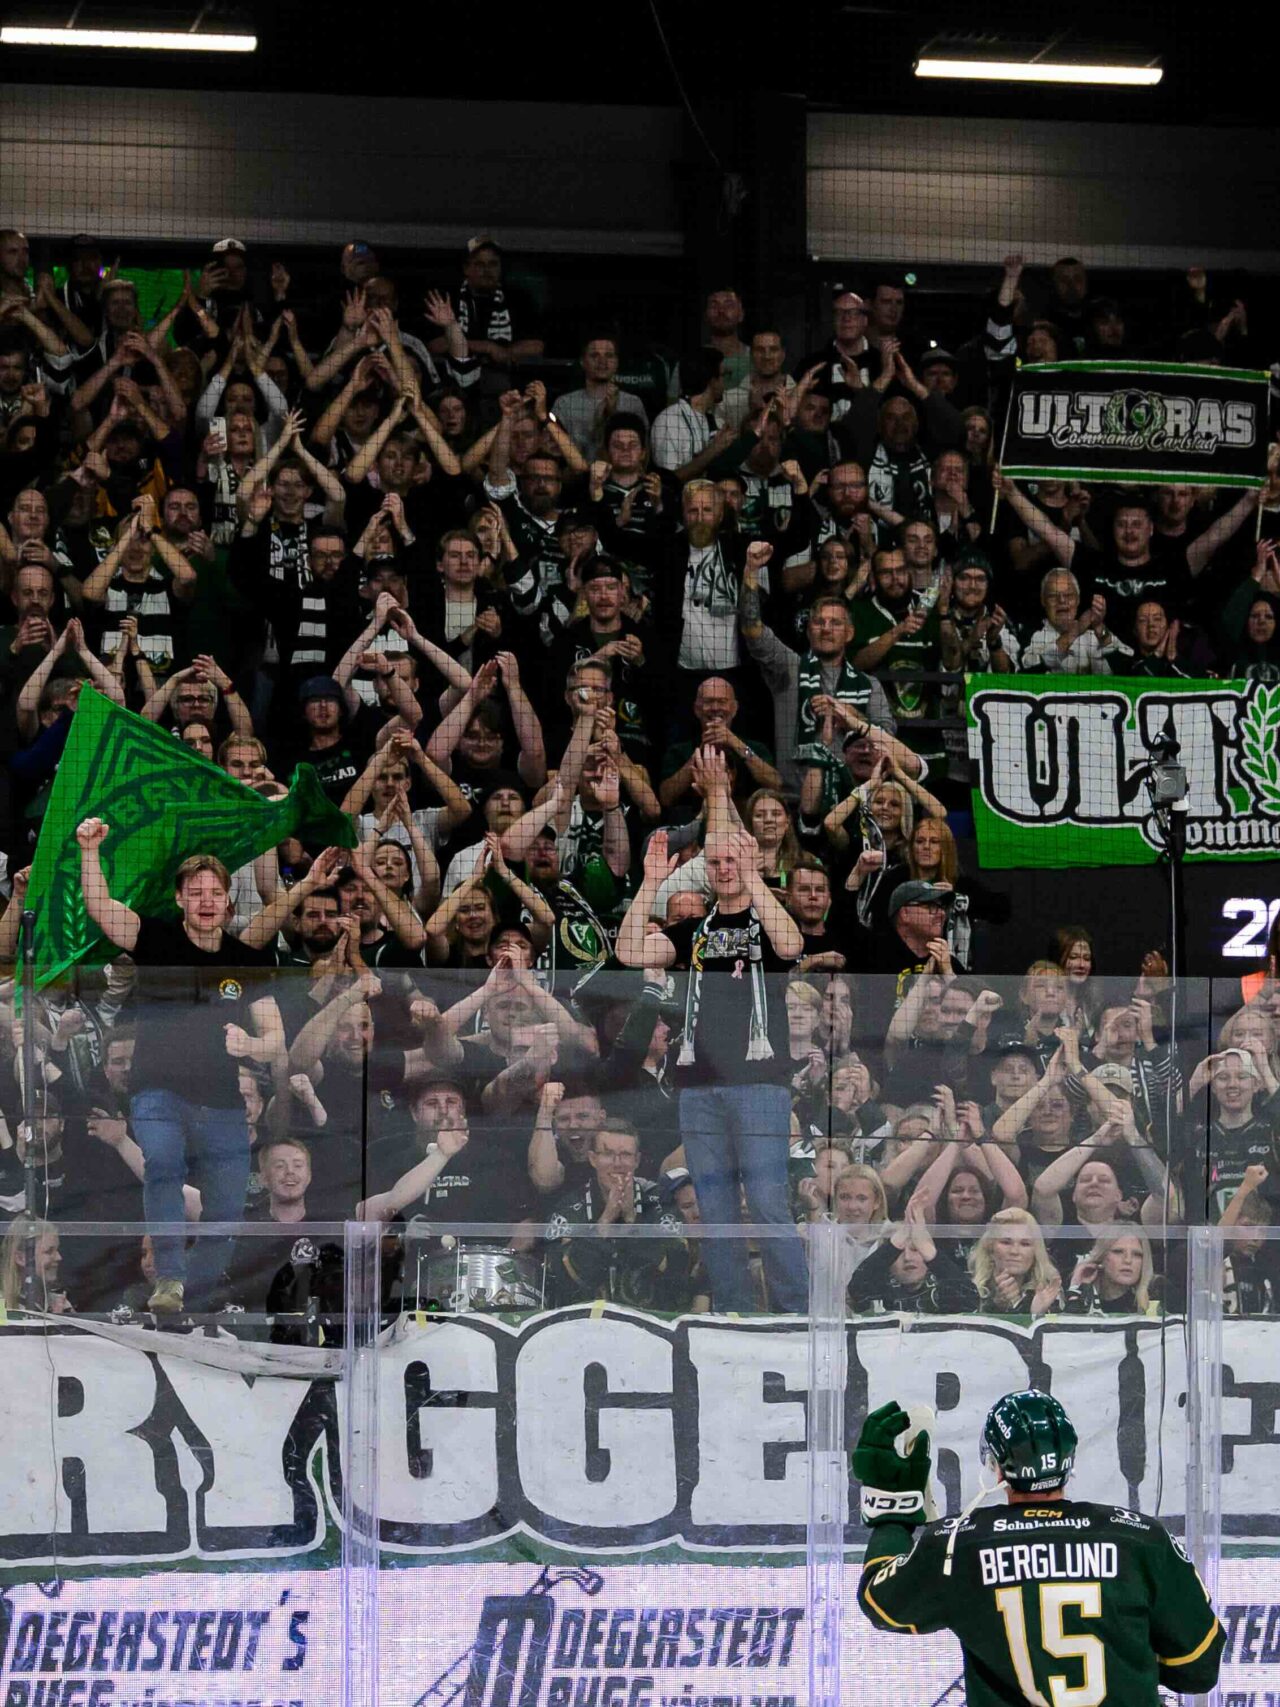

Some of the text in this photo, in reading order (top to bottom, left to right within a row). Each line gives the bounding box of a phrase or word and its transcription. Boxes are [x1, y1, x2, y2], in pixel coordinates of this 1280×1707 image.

[1054, 424, 1145, 446] Commando
[1040, 1452, 1057, 1471] 15
[1023, 1509, 1063, 1518] CCM
[978, 1542, 1118, 1586] BERGLUND
[553, 1607, 838, 1668] DEGERSTEDT
[995, 1581, 1107, 1707] 15
